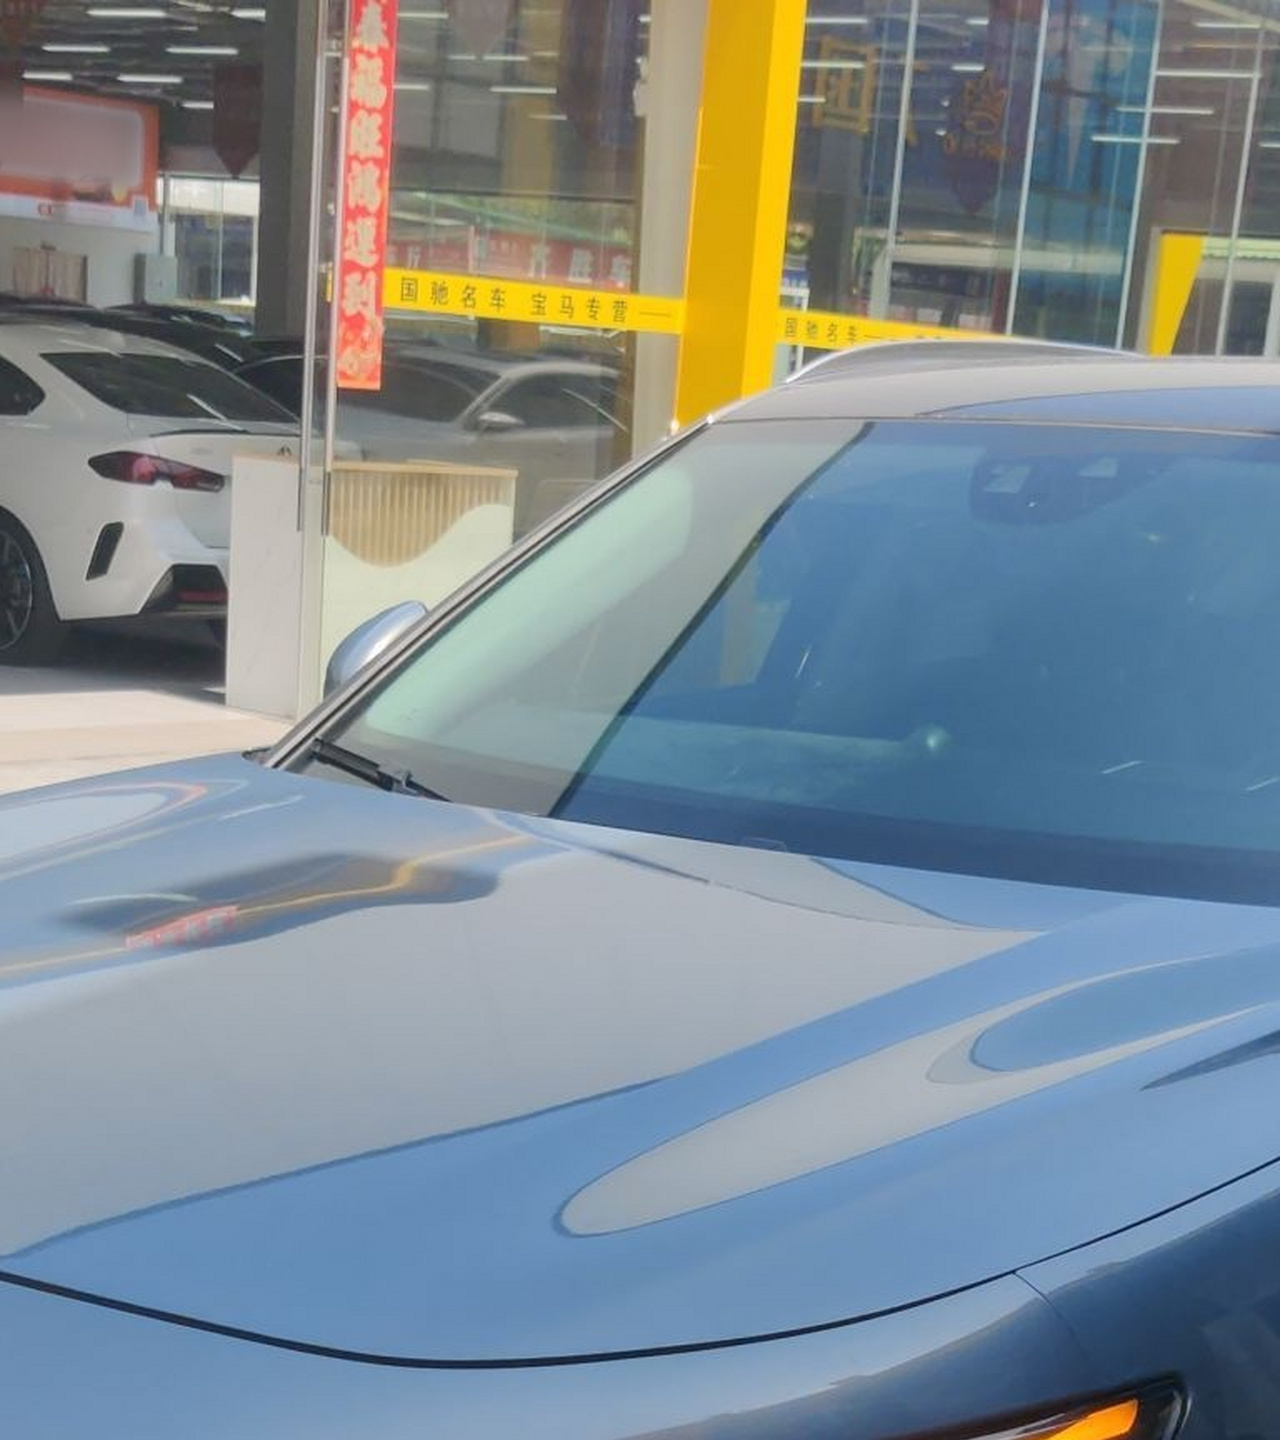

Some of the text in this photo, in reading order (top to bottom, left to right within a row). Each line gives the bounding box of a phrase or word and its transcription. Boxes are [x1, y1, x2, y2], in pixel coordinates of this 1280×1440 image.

[400, 276, 628, 324] 国驰名车 宝马专营
